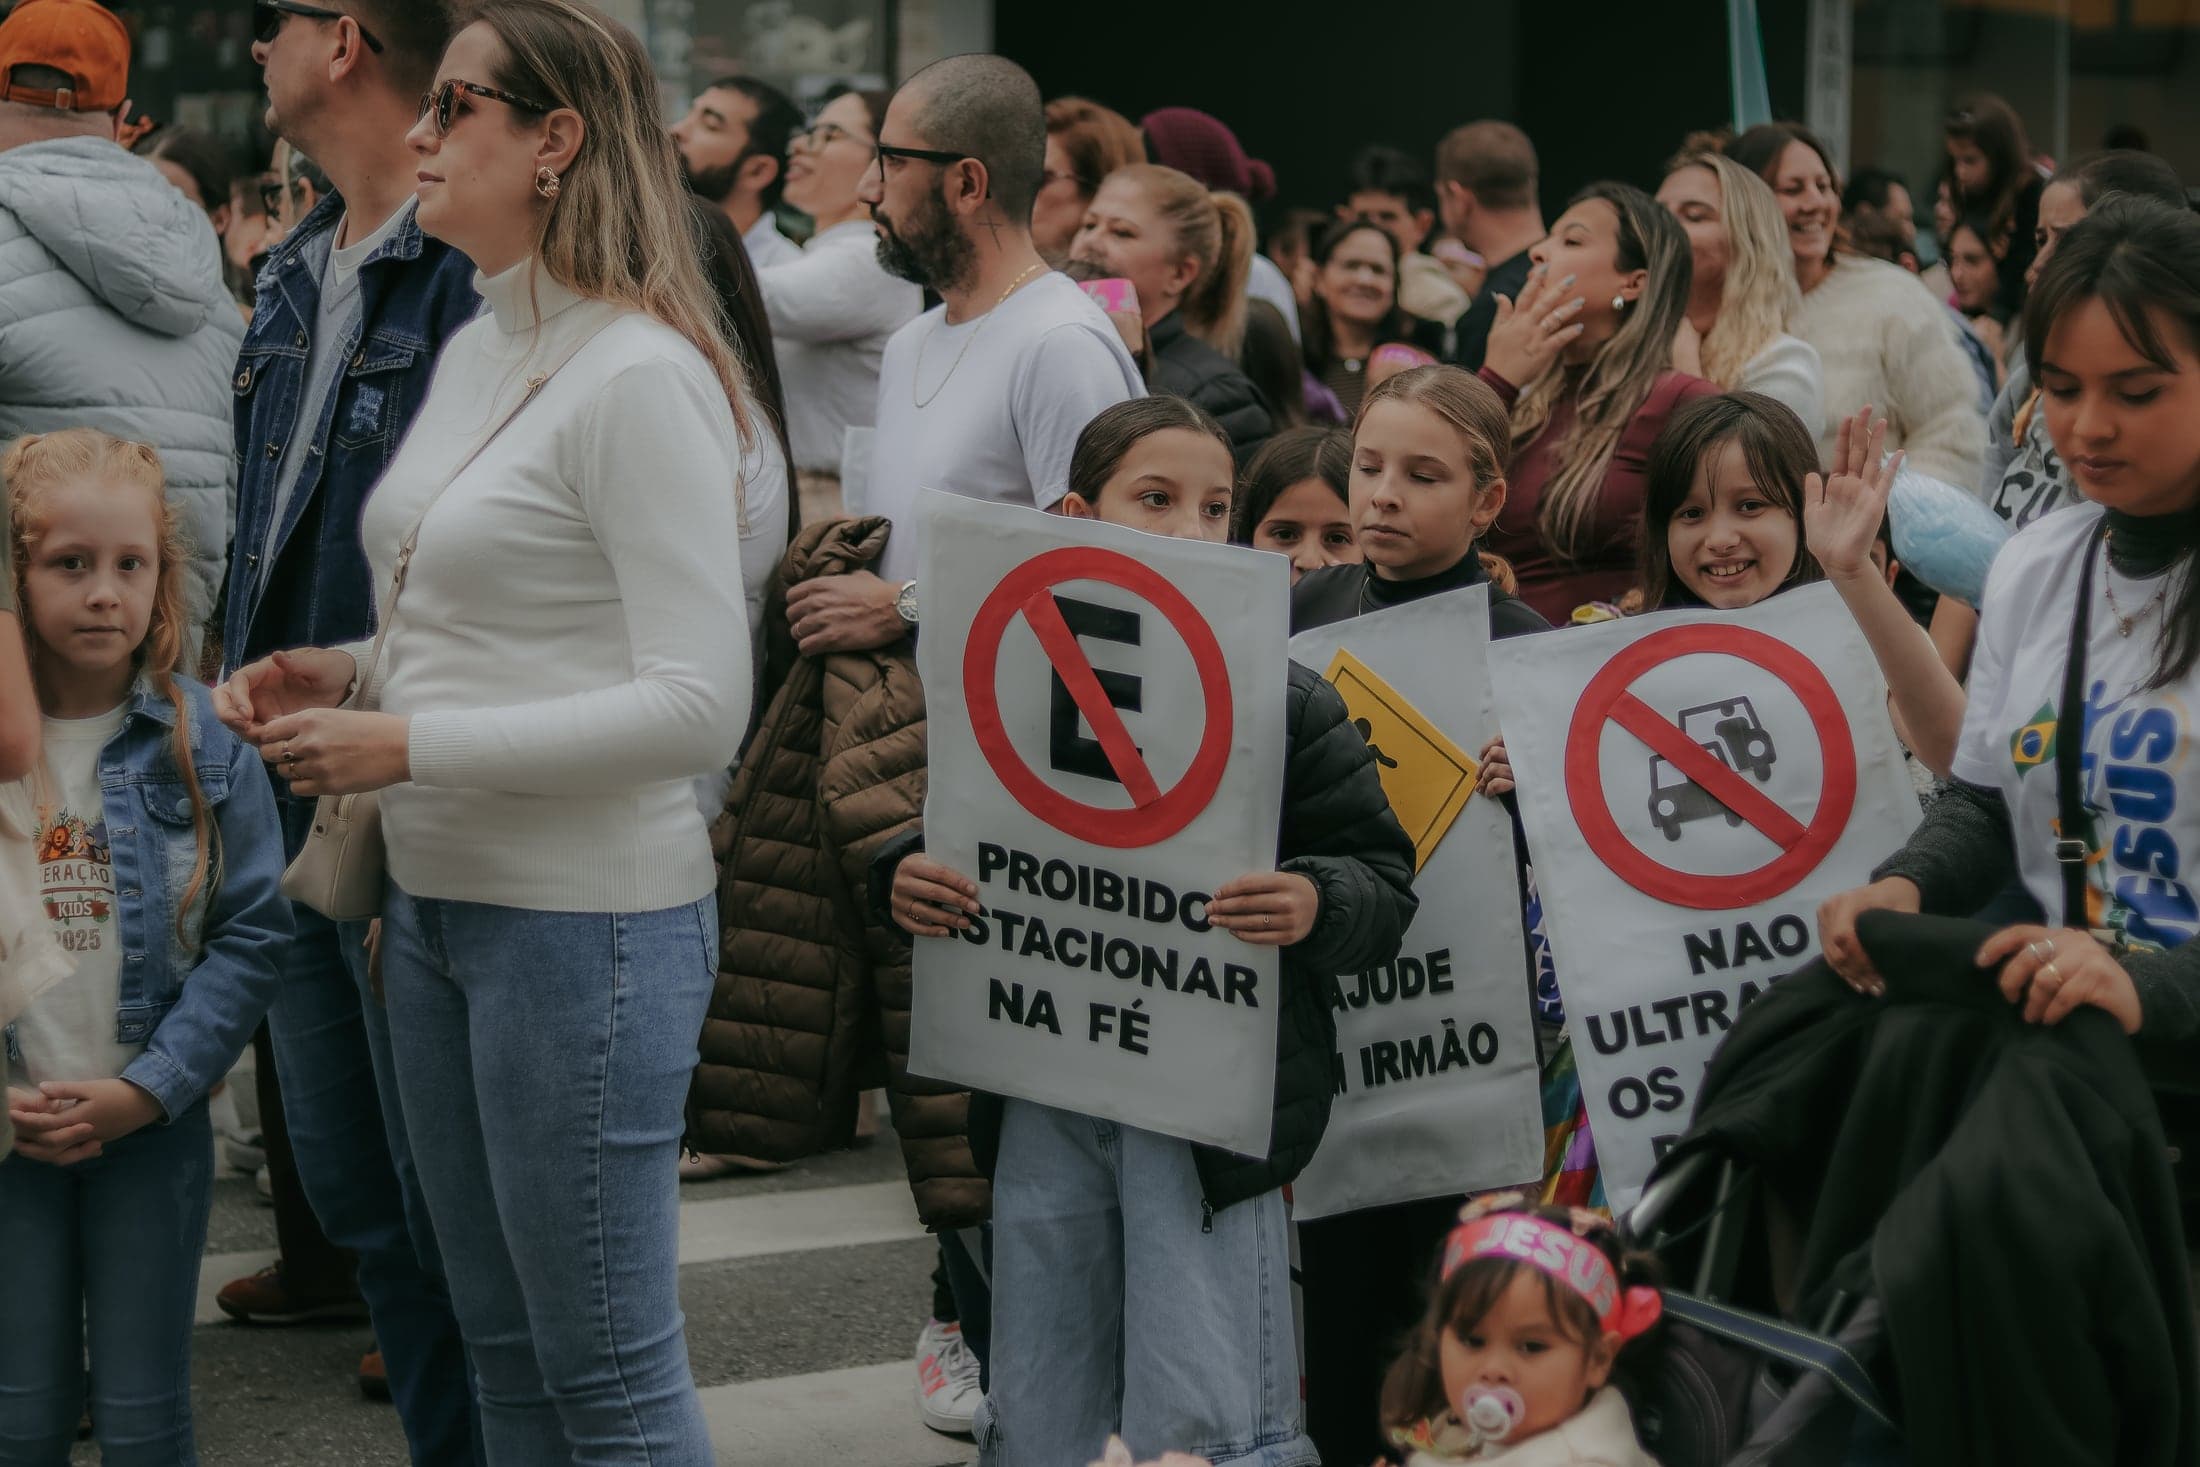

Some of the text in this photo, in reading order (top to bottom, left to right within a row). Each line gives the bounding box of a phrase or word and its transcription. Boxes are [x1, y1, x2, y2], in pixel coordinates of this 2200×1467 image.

[1050, 594, 1143, 784] E
[2105, 707, 2199, 950] JESUS
[43, 862, 110, 886] ERAÇÃO
[57, 901, 93, 918] KIDS
[978, 841, 1216, 932] PROIBIDO
[931, 900, 1259, 1008] STACIONAR
[1683, 914, 1810, 976] NAO
[988, 977, 1150, 1056] NA FÉ
[1360, 1018, 1499, 1088] IRMÃO
[1585, 973, 1792, 1055] ULTR
[1608, 1066, 1685, 1119] OS
[1474, 1217, 1617, 1318] JESUS
